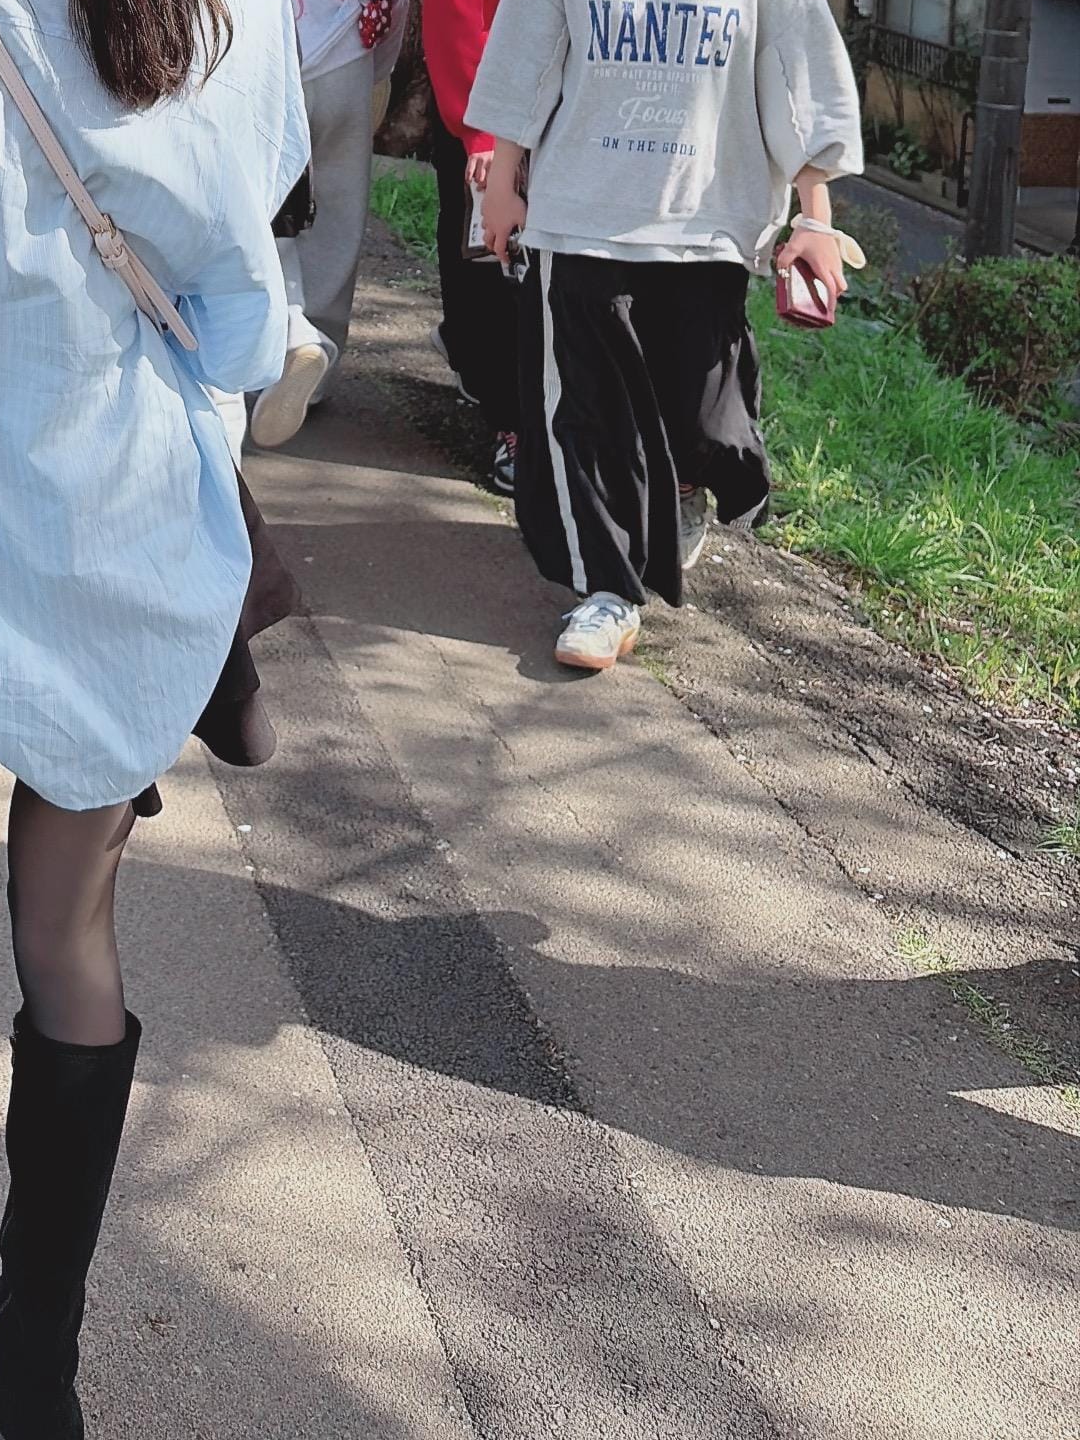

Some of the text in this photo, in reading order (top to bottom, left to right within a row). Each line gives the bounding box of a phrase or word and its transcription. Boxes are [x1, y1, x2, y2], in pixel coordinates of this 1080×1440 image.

[586, 0, 741, 68] NANTES
[618, 94, 689, 130] Focus
[601, 136, 620, 150] ON
[627, 139, 657, 153] THE
